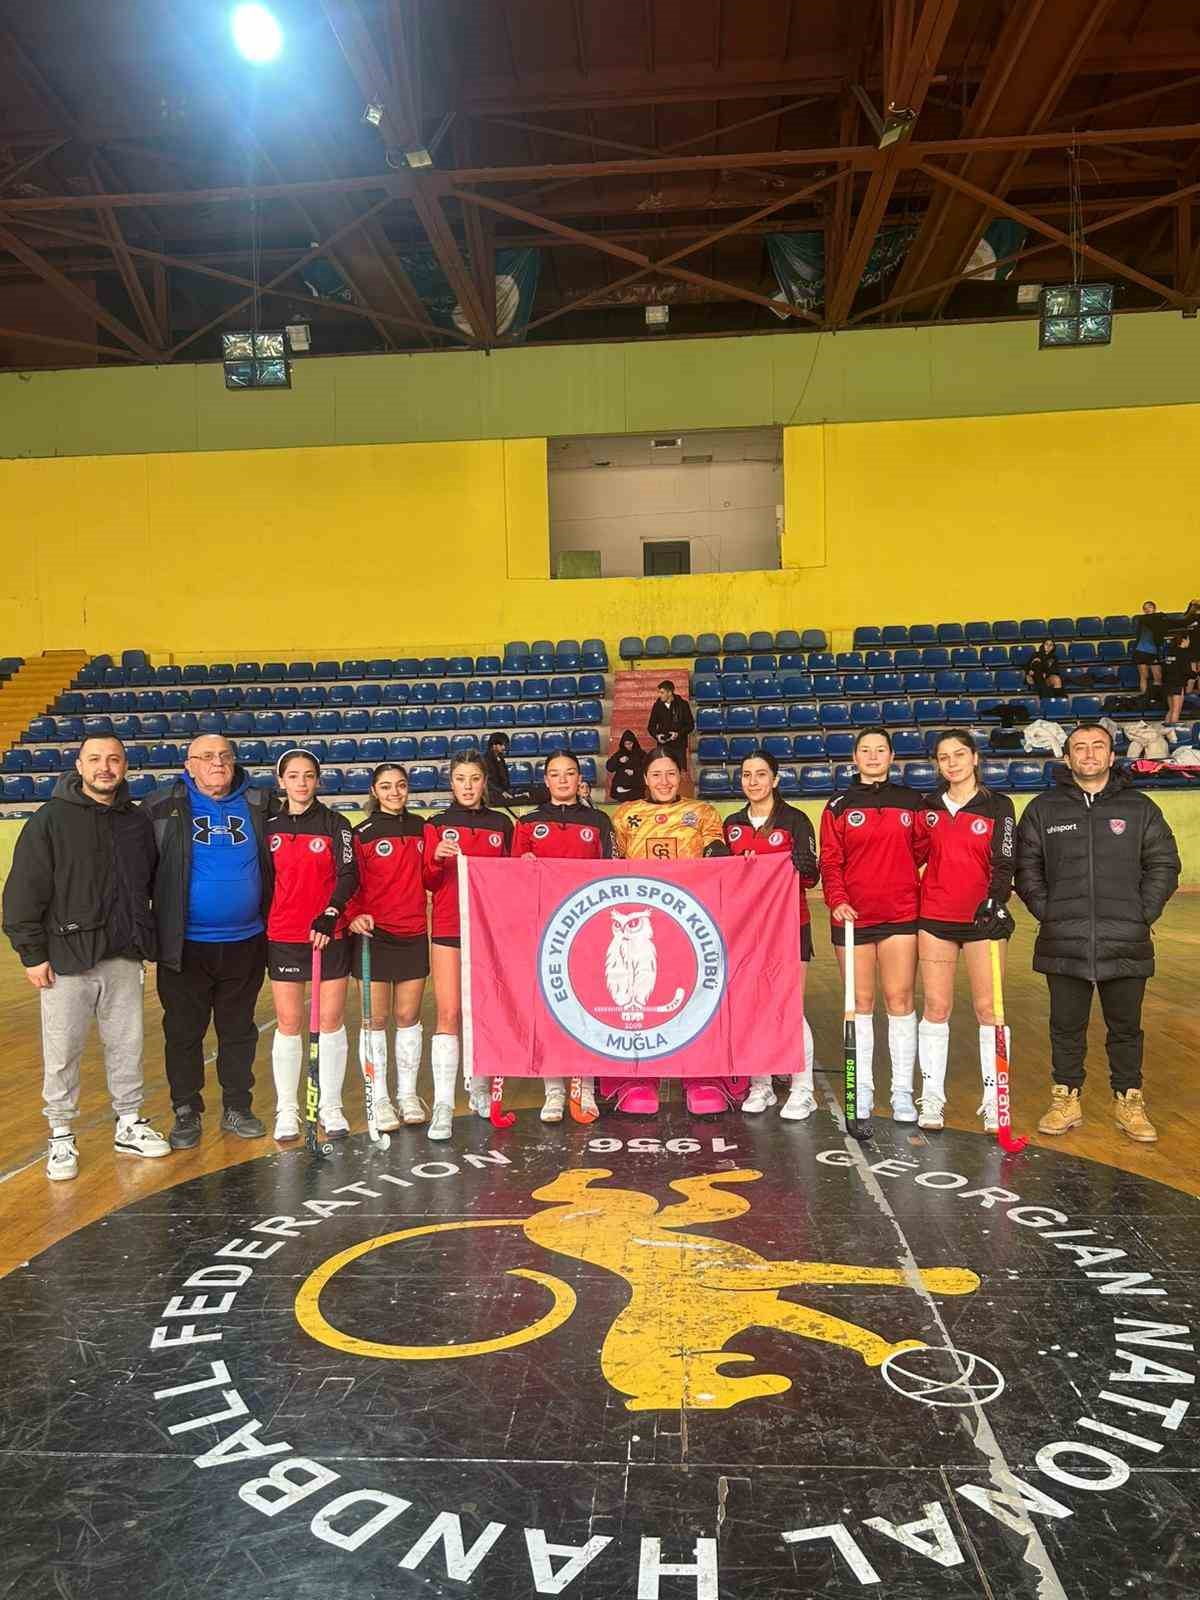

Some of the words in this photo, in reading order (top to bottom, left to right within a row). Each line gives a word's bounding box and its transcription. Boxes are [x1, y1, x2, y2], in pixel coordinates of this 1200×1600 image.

[549, 884, 630, 956] YILDIZLARI
[636, 884, 687, 916] SPOR
[549, 963, 569, 1003] EGE
[686, 913, 720, 990] KULÜBÜ
[606, 1032, 668, 1052] MUĞLA
[846, 1058, 855, 1089] OSAKA
[588, 1137, 738, 1153] 1956
[148, 1149, 512, 1349] FEDERATION
[815, 1149, 1168, 1296] GEORGIAN
[153, 1359, 719, 1600] HANDBALL
[779, 1315, 1197, 1585] NATIONAL
